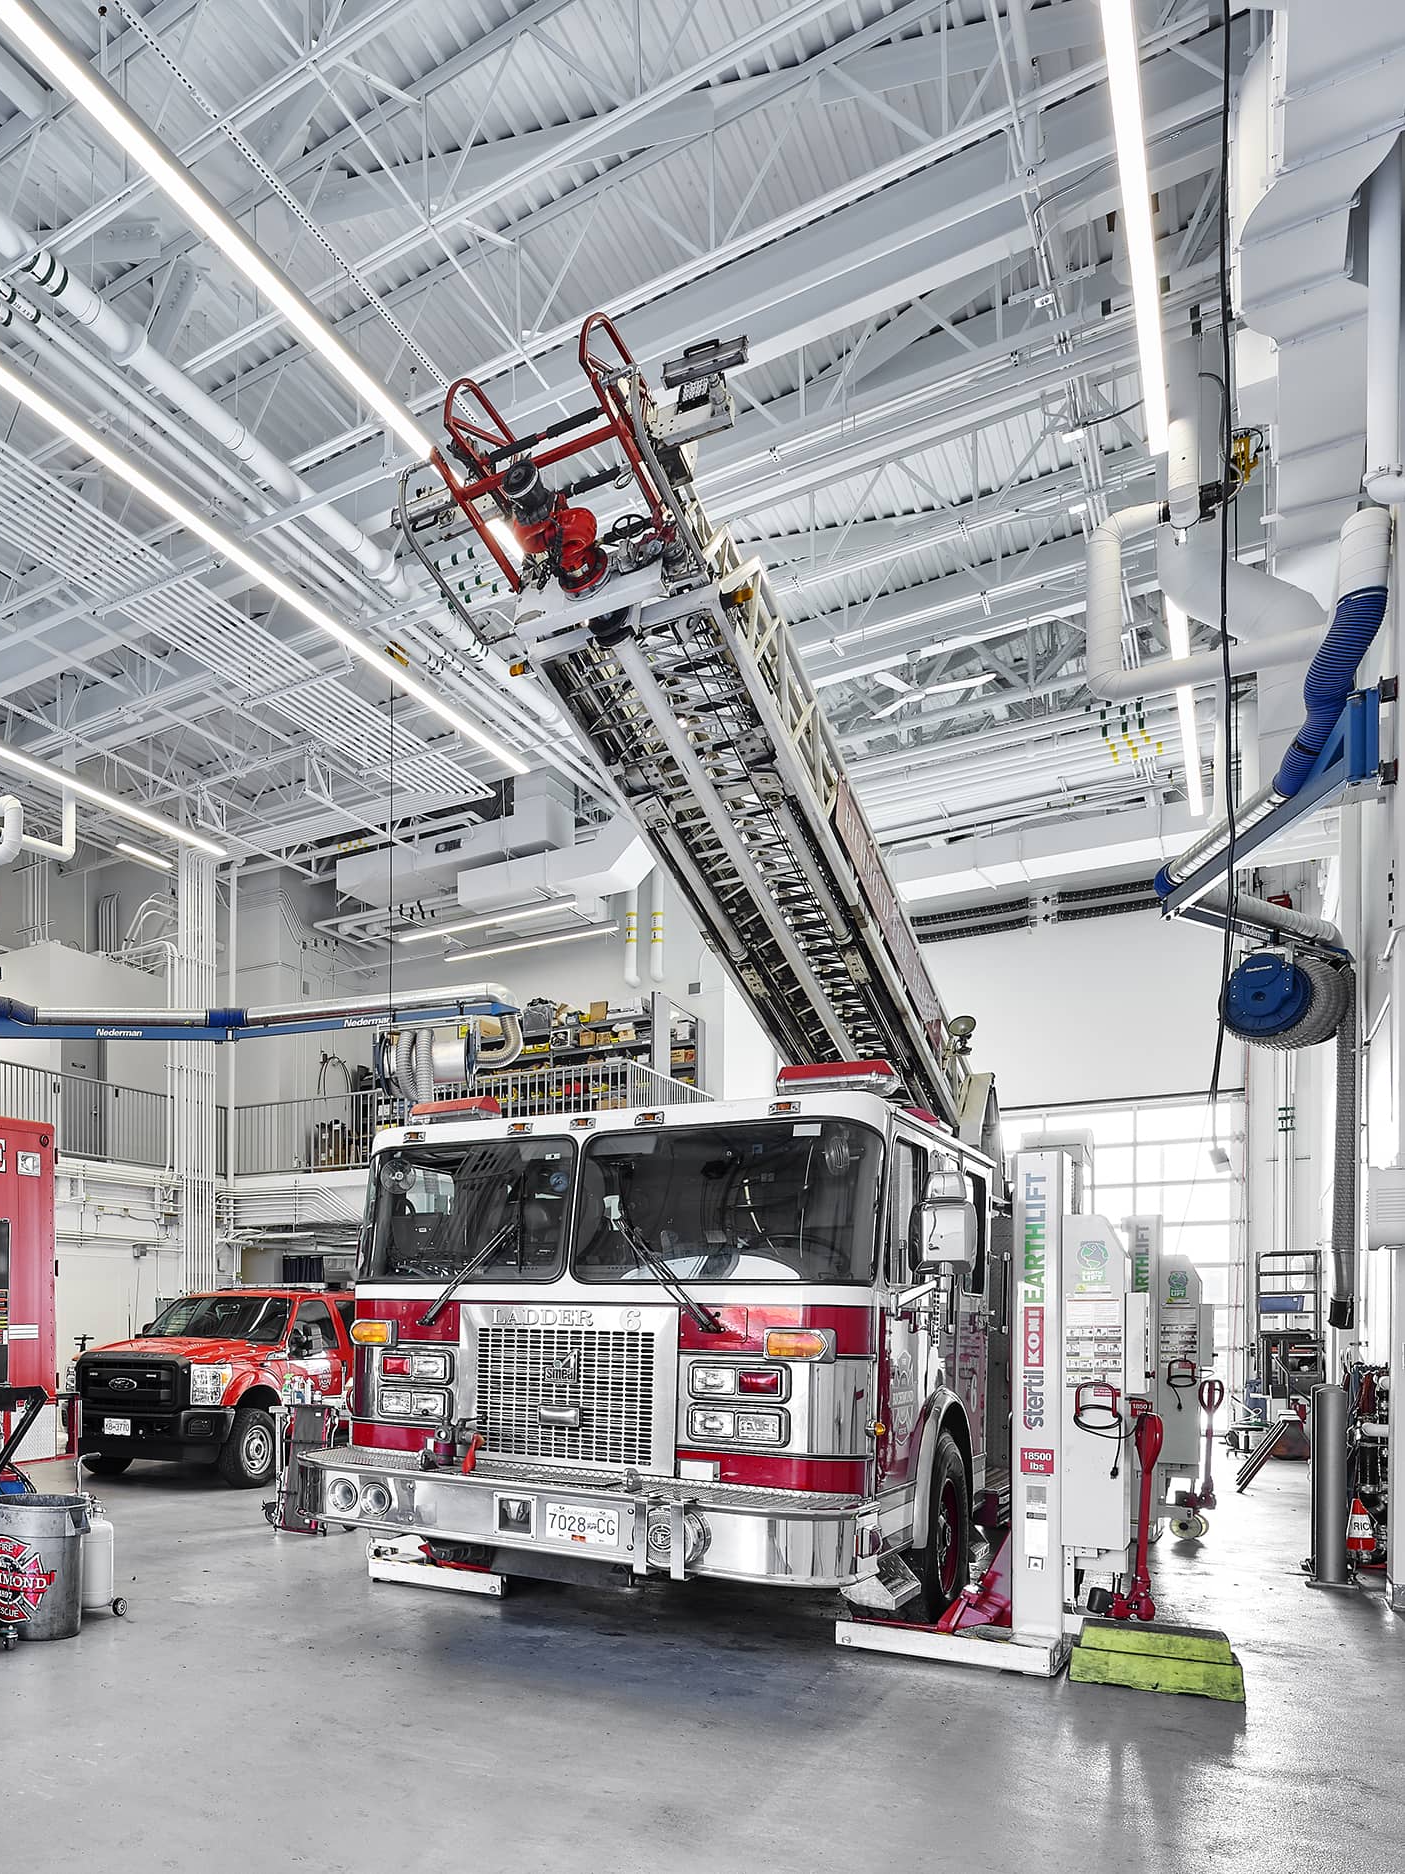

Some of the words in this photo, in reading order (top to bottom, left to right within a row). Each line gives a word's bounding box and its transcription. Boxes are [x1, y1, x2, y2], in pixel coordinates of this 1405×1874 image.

[344, 1016, 393, 1028] Nederman
[96, 1027, 143, 1038] Nederman
[1023, 1172, 1047, 1304] EARTHLIFT
[491, 1307, 595, 1327] LADDER
[619, 1307, 642, 1332] 6
[1027, 1310, 1041, 1365] KONI
[1023, 1452, 1052, 1461] 18500
[1029, 1461, 1045, 1471] lbs
[548, 1512, 586, 1533] 7028
[596, 1518, 616, 1536] CG
